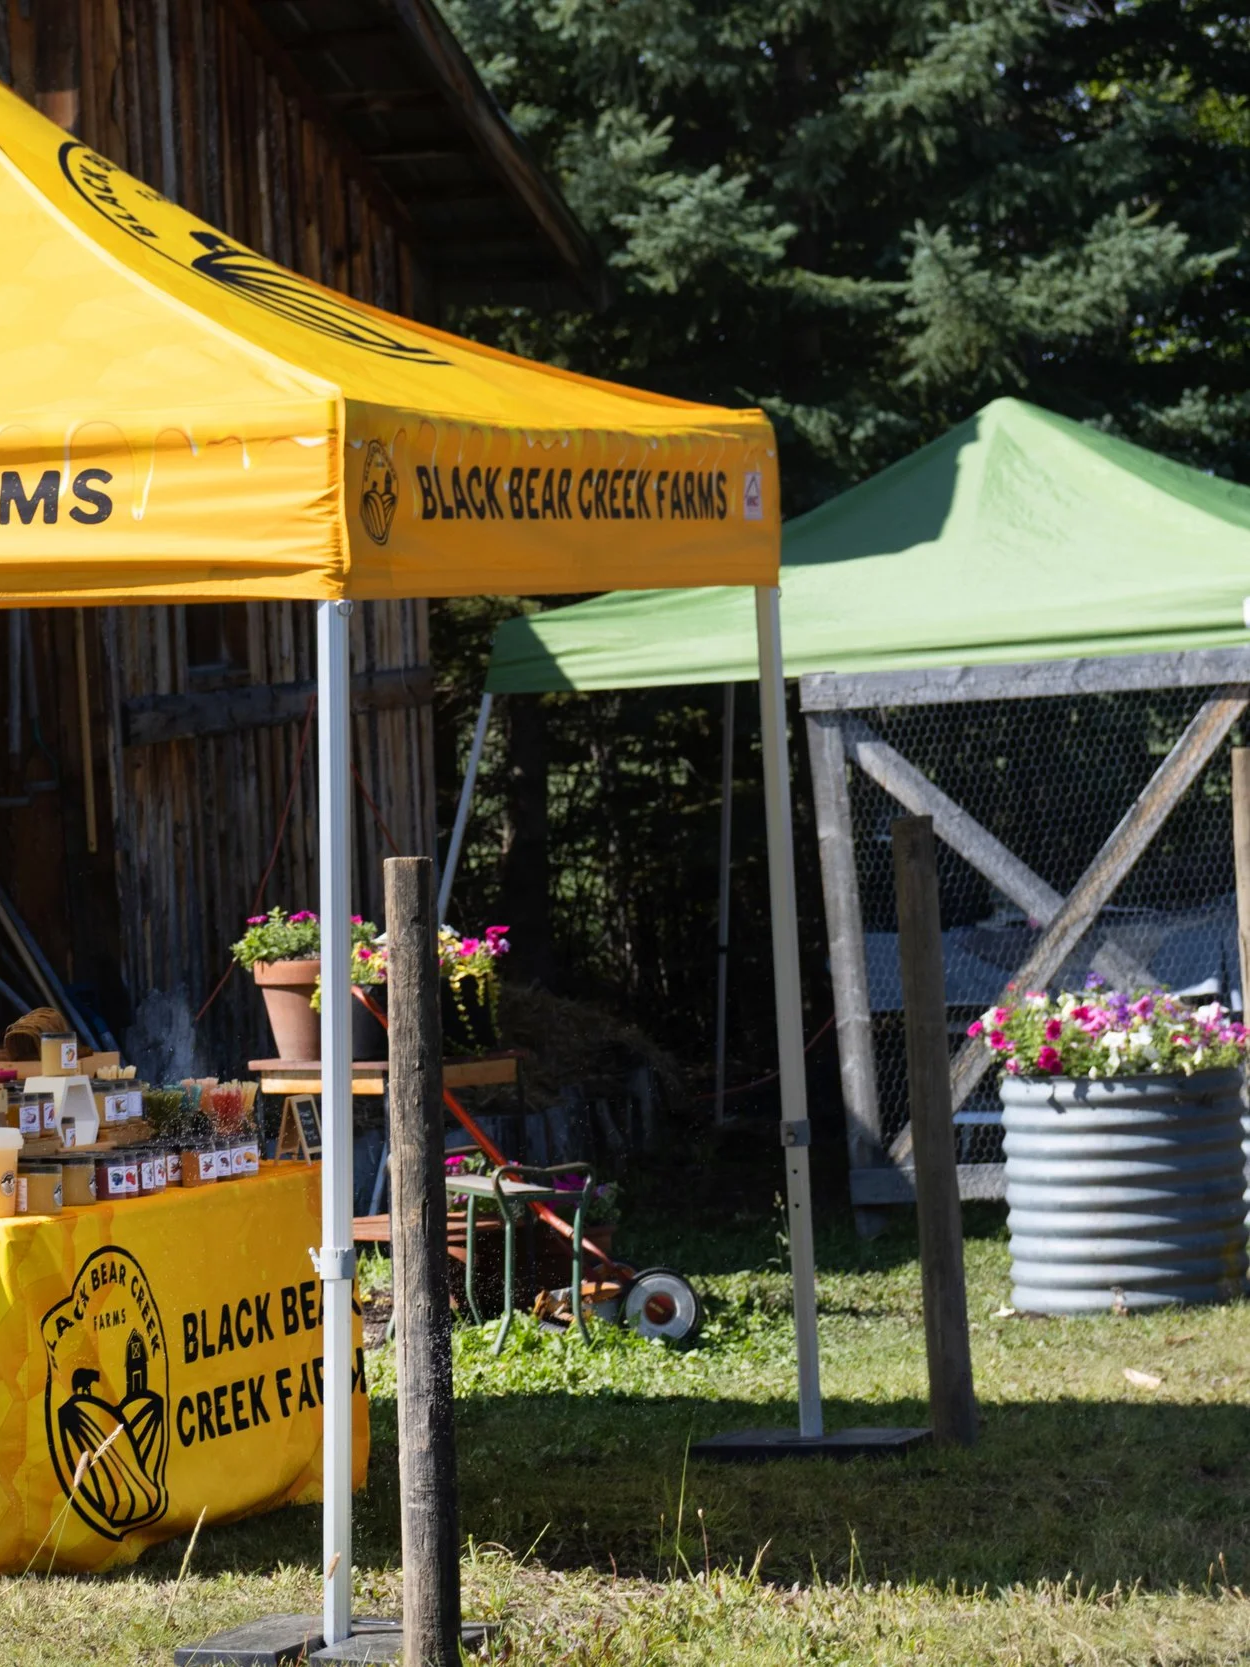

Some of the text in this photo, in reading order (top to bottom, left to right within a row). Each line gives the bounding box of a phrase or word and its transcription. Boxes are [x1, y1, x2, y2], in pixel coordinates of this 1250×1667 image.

[416, 465, 504, 520] BLACK
[509, 467, 573, 520] BEAR
[578, 468, 652, 520] CREEK
[656, 470, 727, 520] FARMS
[90, 1261, 127, 1292] BEAR
[131, 1275, 161, 1358] CREEK
[93, 1308, 126, 1332] FARMS
[183, 1292, 275, 1364] BLACK
[176, 1374, 271, 1447] CREEK
